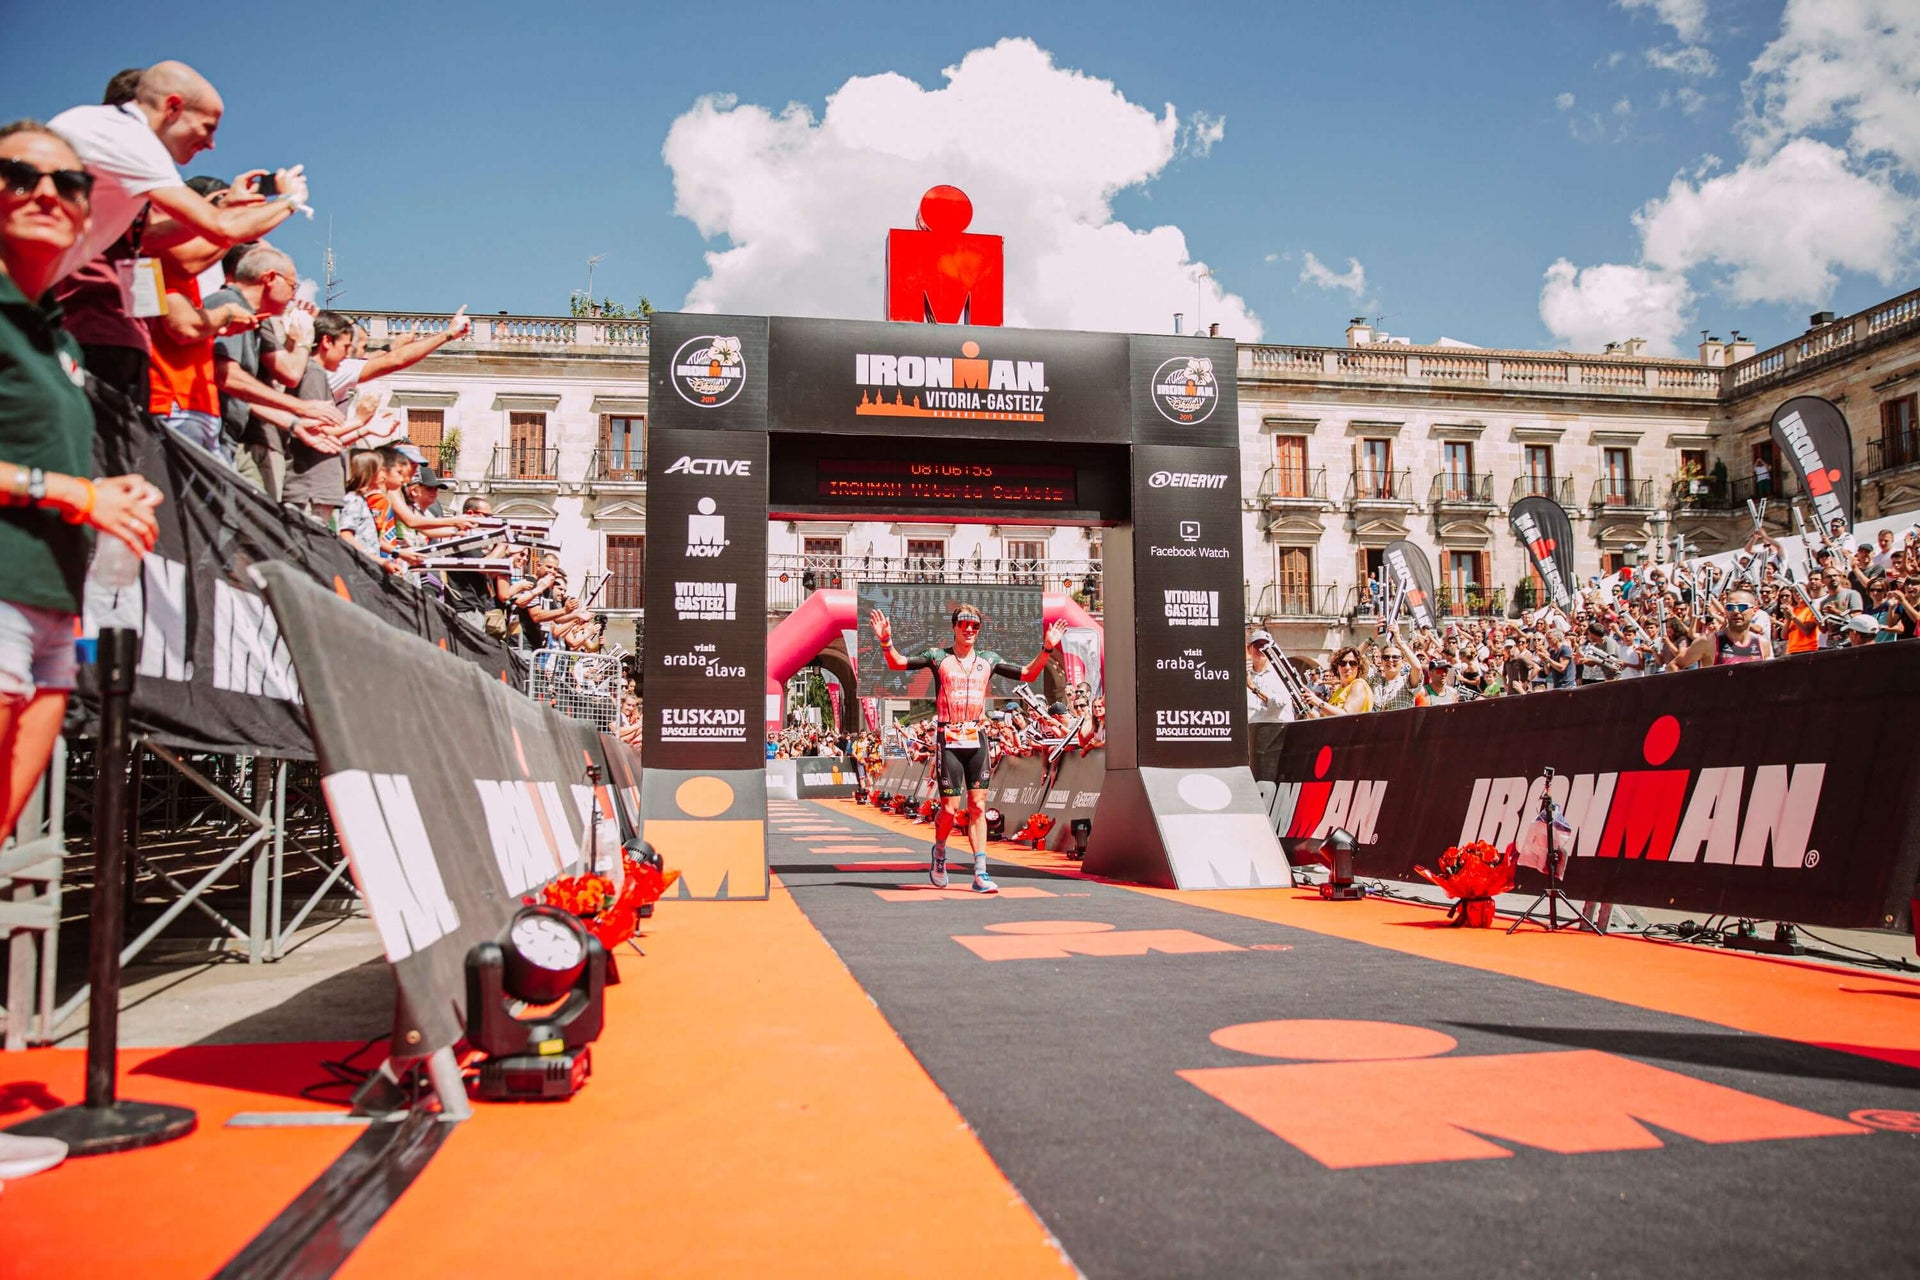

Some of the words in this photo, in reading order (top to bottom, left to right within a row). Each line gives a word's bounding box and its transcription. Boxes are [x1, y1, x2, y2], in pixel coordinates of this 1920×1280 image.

[856, 341, 1044, 392] IRONMAN
[926, 391, 1043, 412] VITORIA-GASTEIZ
[664, 456, 752, 476] ACTIVE
[1170, 472, 1228, 489] ENERVIT
[685, 545, 724, 557] NOW
[1151, 546, 1197, 557] Facebook
[1199, 547, 1229, 559] Watch
[675, 582, 725, 597] VITORIA
[675, 597, 725, 611] GASTEIZ
[1164, 590, 1209, 604] VITORIA
[1164, 604, 1209, 618] GASTEIZ
[694, 644, 716, 652] visit
[664, 652, 706, 666] araba
[1156, 657, 1194, 669] araba
[662, 709, 745, 725] EUSKADI
[1156, 710, 1230, 725] EUSKADI
[661, 727, 698, 736] BASQUE
[698, 727, 746, 736] COUNTRY
[1156, 728, 1188, 736] BASQUE
[1189, 728, 1231, 736] COUNTRY
[1458, 714, 1826, 868] IRONMAN
